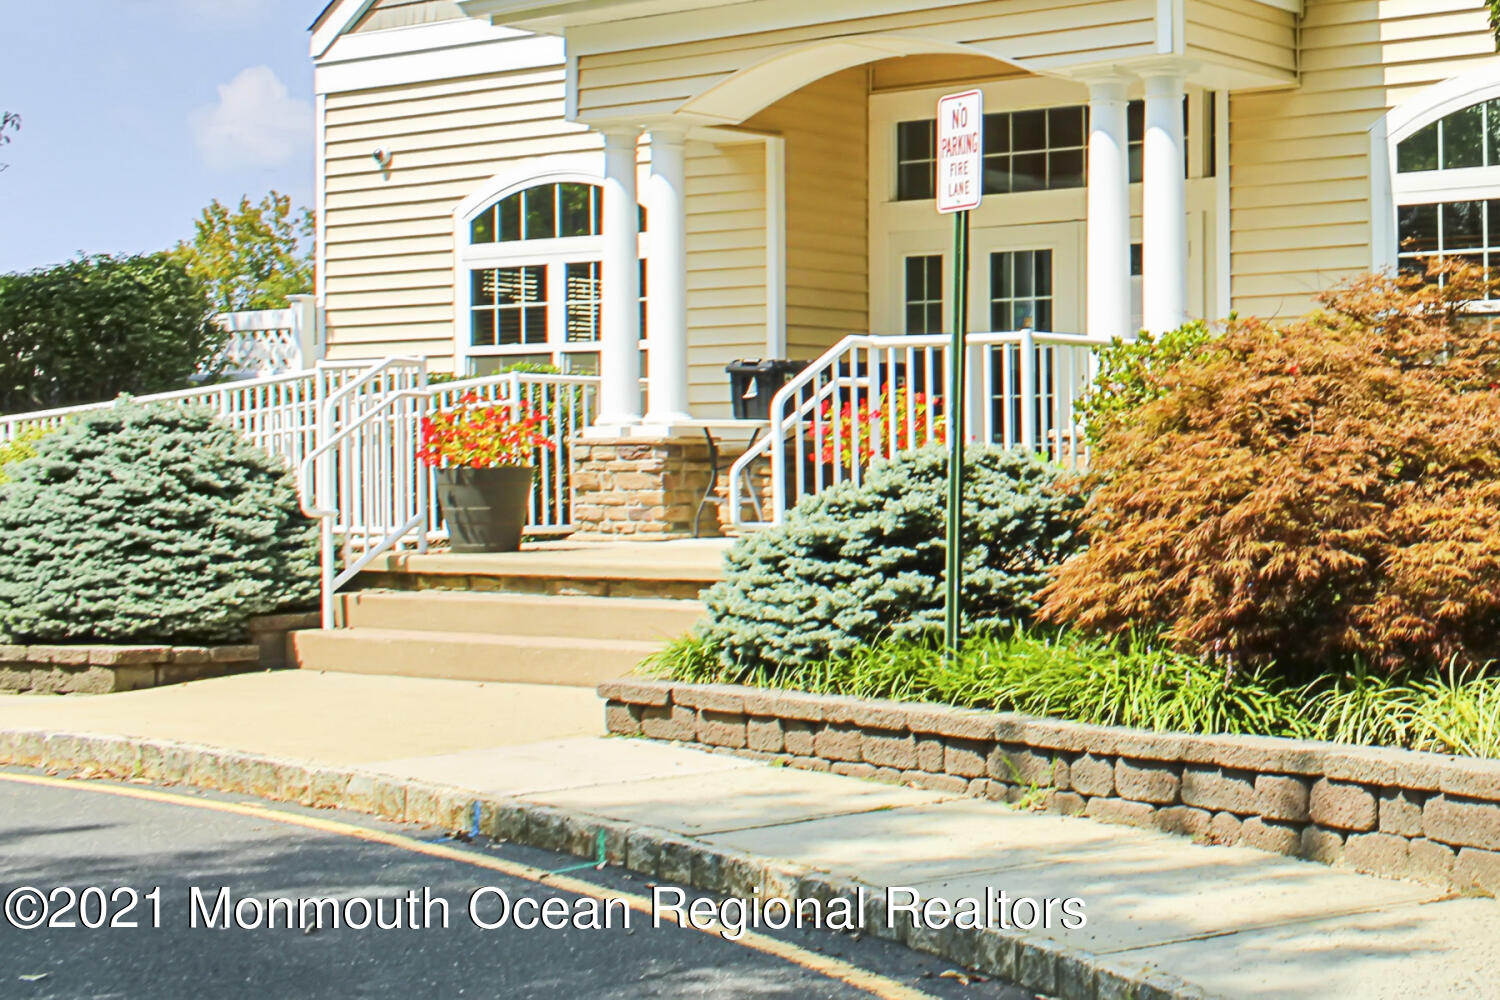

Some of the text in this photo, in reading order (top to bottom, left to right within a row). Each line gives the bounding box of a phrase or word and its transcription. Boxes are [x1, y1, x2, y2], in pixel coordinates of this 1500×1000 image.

[952, 106, 968, 130] NO
[941, 132, 979, 158] PARKING
[949, 160, 969, 177] FIRE
[948, 180, 970, 198] LANE
